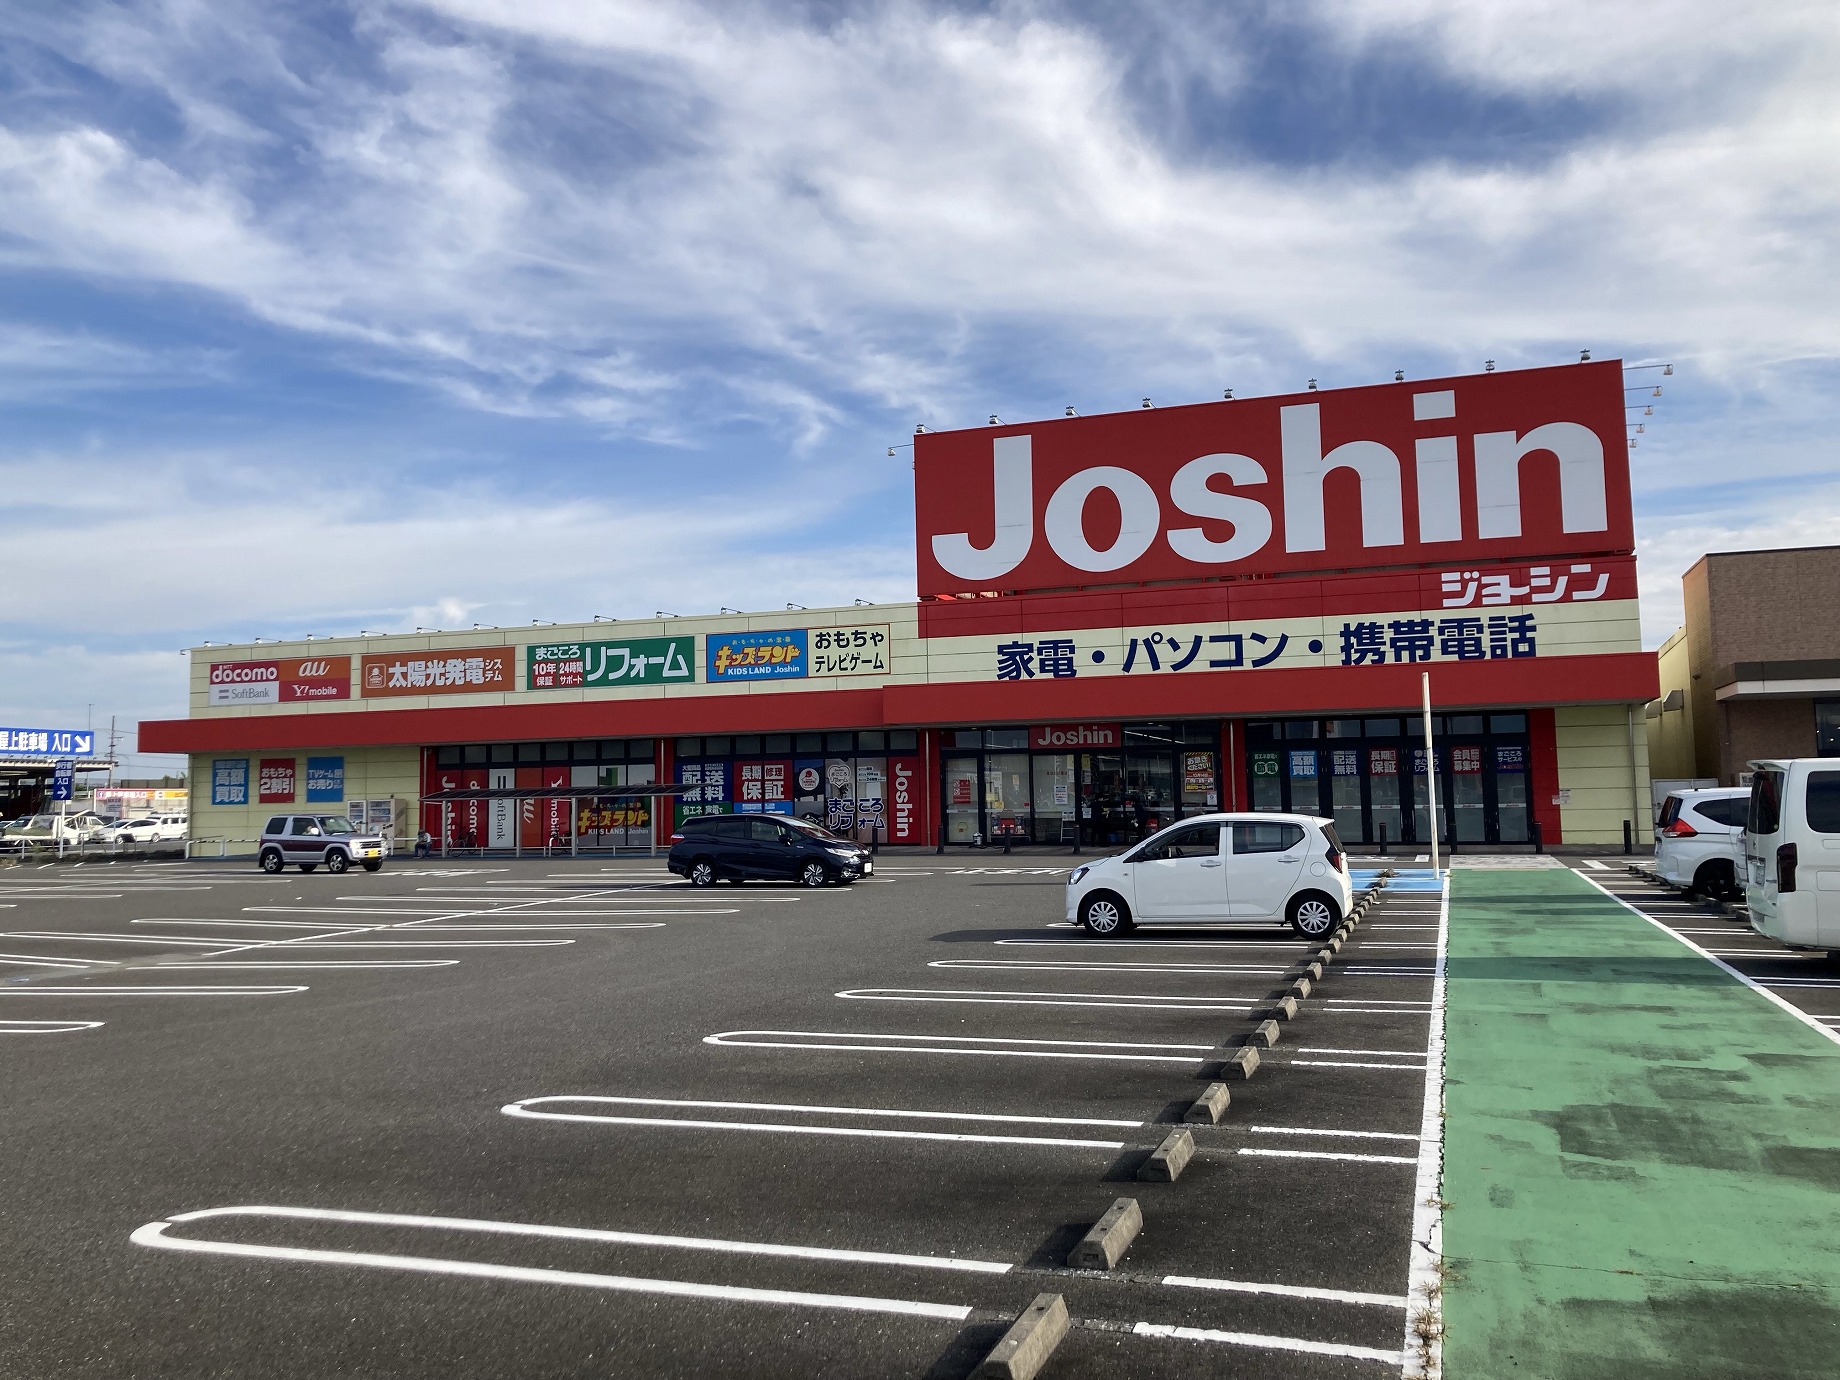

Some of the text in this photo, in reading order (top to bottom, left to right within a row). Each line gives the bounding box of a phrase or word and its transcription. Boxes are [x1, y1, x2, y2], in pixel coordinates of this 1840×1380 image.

[931, 389, 1609, 581] Joshin
[1441, 563, 1610, 608] ジョーシン
[815, 630, 884, 649] おもちゃ
[996, 613, 1537, 682] 家電・パソコン・携帯電話
[535, 645, 581, 660] まごころ
[714, 644, 801, 674] キッズランド
[299, 660, 330, 677] au
[485, 659, 502, 670] シス
[533, 663, 557, 675] 10年
[559, 662, 583, 673] 24時間
[585, 642, 690, 681] リフォーム
[815, 651, 884, 673] テレビゲーム
[212, 665, 278, 683] docomo
[388, 658, 484, 688] 太陽光発電
[485, 671, 503, 681] テム
[728, 665, 800, 675] KIDS LAND Joshin
[536, 676, 553, 686] 保証
[560, 675, 583, 685] サポート
[231, 687, 270, 699] SoftBank
[52, 732, 71, 752] 入口
[1037, 726, 1113, 745] Joshin
[1292, 755, 1315, 765] 高額
[1333, 754, 1356, 765] 配送
[1453, 750, 1471, 760] 会員
[261, 768, 293, 778] おもちゃ
[1292, 765, 1315, 775] 買取
[1334, 765, 1357, 774] 無料
[1371, 761, 1396, 773] 保証
[1453, 760, 1480, 771] 募集中
[215, 769, 245, 785] 高額
[682, 771, 724, 785] 配送
[215, 786, 245, 802] 買取
[260, 778, 294, 794] 2割引
[742, 781, 785, 800] 保証
[828, 797, 884, 813] まごころ
[896, 763, 913, 837] Joshin
[496, 799, 507, 840] oftBank
[829, 814, 885, 830] リフォーム
